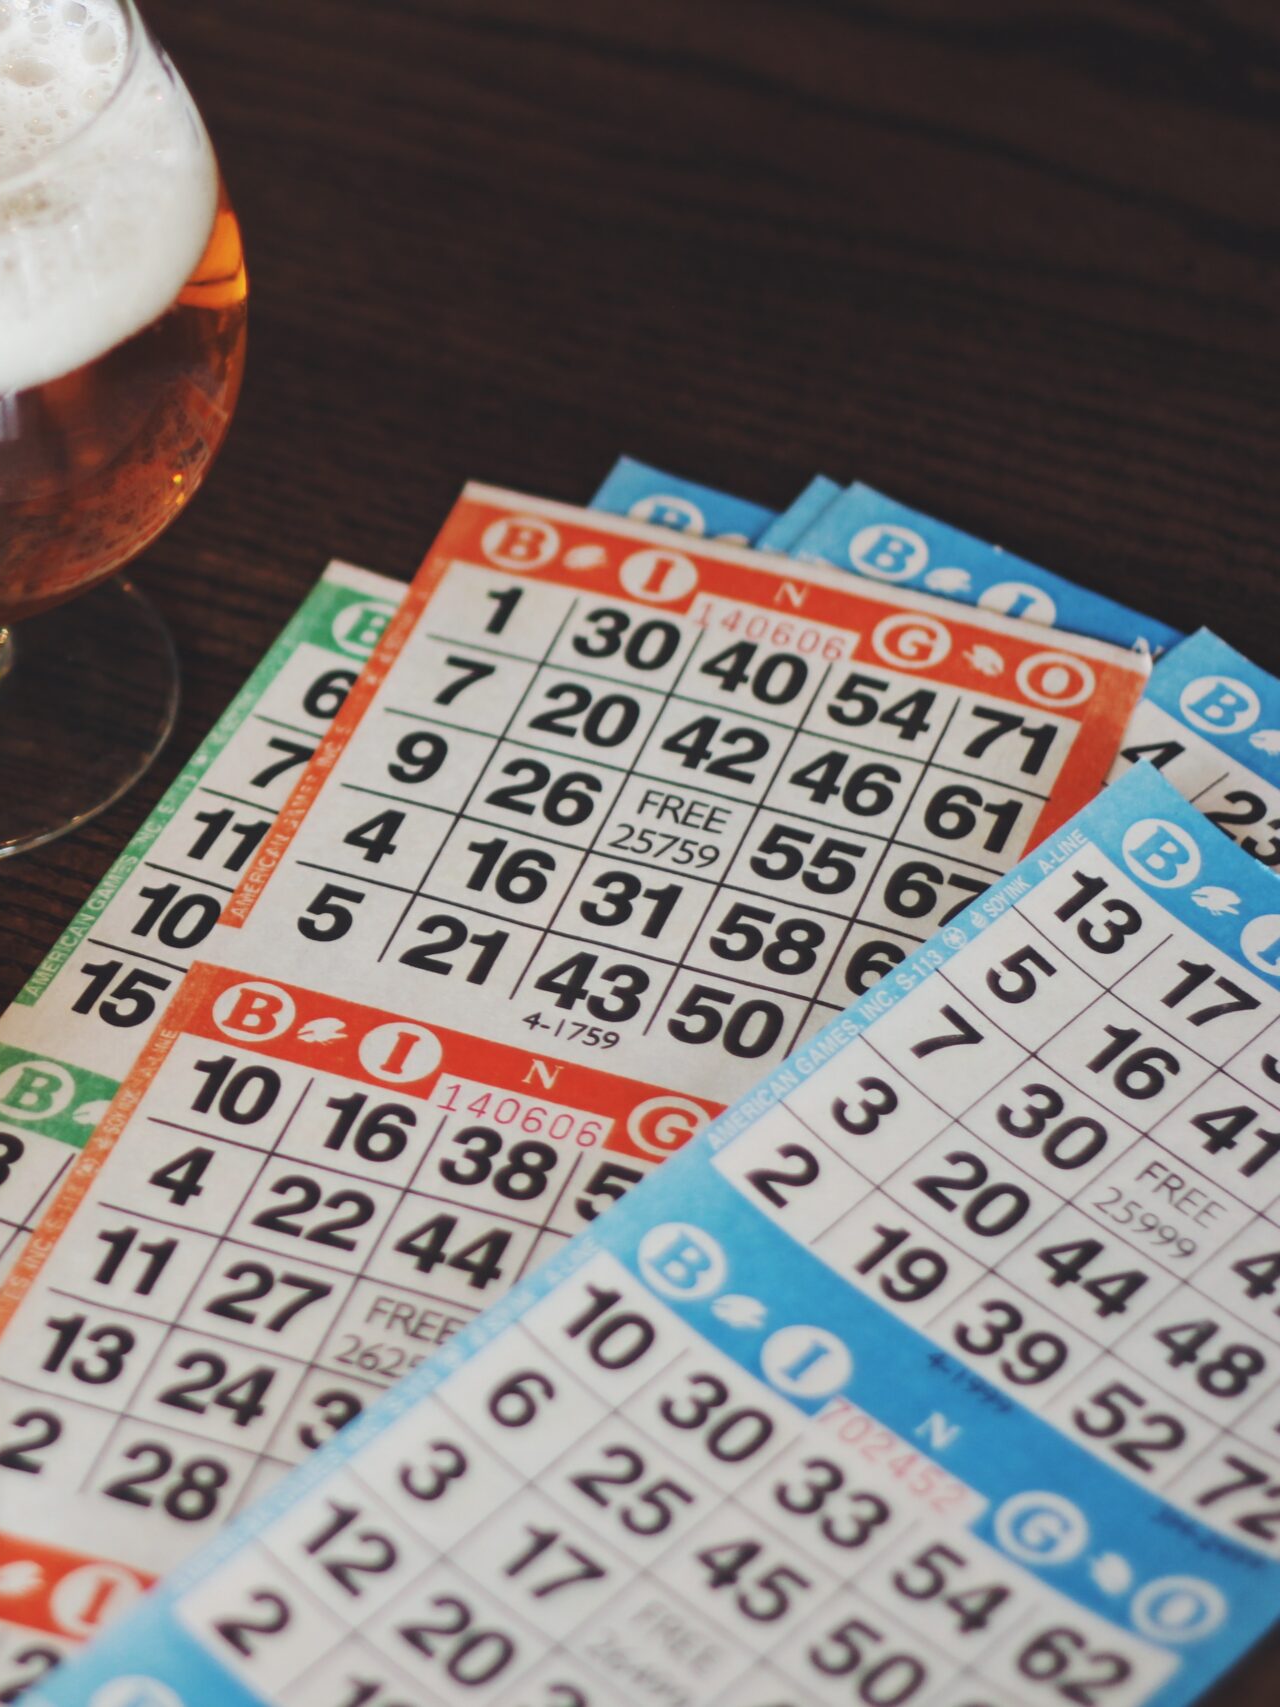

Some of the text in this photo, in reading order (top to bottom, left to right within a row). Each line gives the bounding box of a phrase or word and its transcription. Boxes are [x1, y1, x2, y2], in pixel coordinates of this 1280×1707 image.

[860, 531, 917, 574] B
[345, 607, 392, 648] B
[497, 519, 1085, 700] B I N G O
[694, 604, 845, 661] 140606
[303, 669, 359, 720] 6
[485, 586, 524, 635] 1
[571, 608, 681, 671] 30
[699, 641, 809, 705] 40
[827, 673, 937, 741] 54
[963, 706, 1059, 775] 71
[1187, 682, 1250, 727] B
[250, 737, 314, 788] 7
[387, 730, 448, 784] 9
[484, 758, 602, 827] 26
[433, 655, 1023, 853] 7 20 42 46 61
[187, 808, 272, 872] 11
[608, 824, 720, 868] 25759
[637, 789, 732, 834] FREE
[1128, 826, 1190, 882] B
[131, 883, 221, 949] 10
[229, 831, 291, 919] AMERICAN
[343, 809, 907, 997] 4 16 31 58 6
[749, 823, 991, 928] 55 67
[25, 912, 95, 997] AMERICAN
[71, 960, 171, 1028] 15
[297, 883, 785, 1059] 5 21 43 50
[707, 1067, 798, 1149] AMERICAN
[896, 949, 944, 990] S-113
[982, 894, 1010, 919] SOY
[1004, 876, 1032, 903] INK
[1039, 828, 1091, 876] A-LINE
[1054, 870, 1261, 1027] 13 17
[221, 987, 699, 1150] B I N G
[522, 1012, 620, 1050] 4-1759
[986, 945, 1180, 1099] 5 16
[0, 1067, 62, 1113] B
[191, 1055, 644, 1221] 10 16 38 5
[437, 1084, 603, 1148] 140606
[911, 1004, 1280, 1178] 7 30 41
[831, 1076, 1031, 1237] 3 20
[1135, 1161, 1228, 1229] FREE
[148, 1146, 216, 1207] 4
[251, 1174, 375, 1252] 22
[393, 1213, 513, 1290] 44
[1094, 1186, 1199, 1259] 25999
[93, 1226, 334, 1333] 11 27
[745, 1142, 1266, 1398] 2 19 44 48
[1231, 1251, 1280, 1318] 4
[365, 1295, 468, 1345] FREE
[42, 1314, 135, 1384] 13
[157, 1350, 277, 1427] 24
[298, 1389, 363, 1450] 3
[648, 1232, 712, 1289] B
[782, 1340, 832, 1381] I
[914, 1412, 963, 1448] N
[1010, 1508, 1072, 1553] G
[954, 1299, 1068, 1385] 39
[1074, 1382, 1186, 1473] 52
[102, 1443, 229, 1522] 28
[565, 1281, 655, 1369] 10
[661, 1372, 773, 1462] 30
[775, 1459, 890, 1548] 33
[893, 1544, 1010, 1635] 54
[1017, 1626, 1131, 1707] 62
[819, 1398, 968, 1512] 702452
[400, 1441, 606, 1598] 3 17
[489, 1370, 554, 1427] 6
[571, 1445, 694, 1535] 25
[697, 1541, 812, 1622] 45
[808, 1619, 926, 1707] 50
[80, 1577, 118, 1624] I
[214, 1591, 291, 1657] 2
[304, 1500, 397, 1597] 12
[400, 1597, 515, 1685] 20
